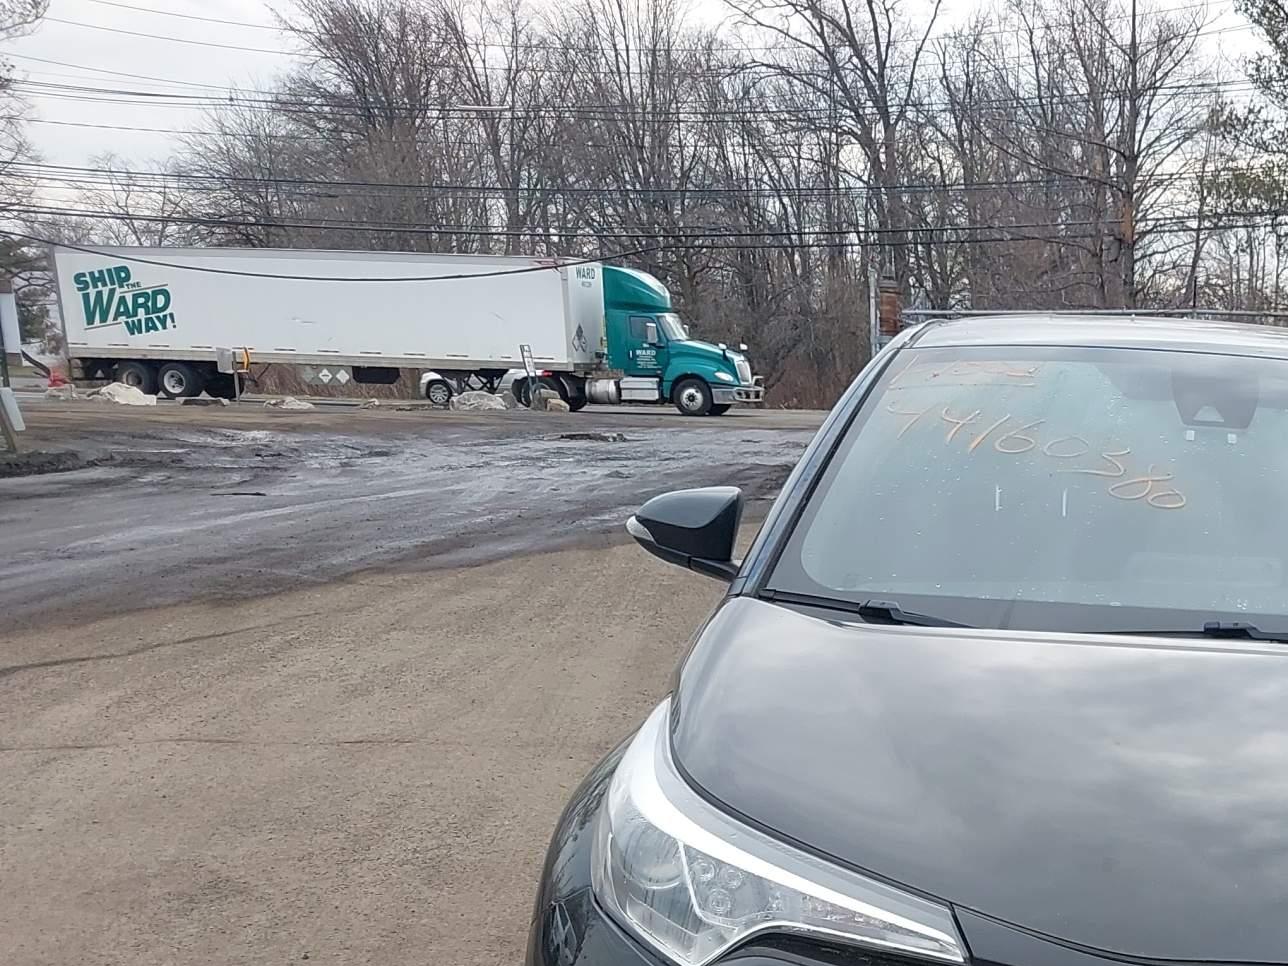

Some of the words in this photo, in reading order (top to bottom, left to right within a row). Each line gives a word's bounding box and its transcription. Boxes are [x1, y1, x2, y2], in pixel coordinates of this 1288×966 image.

[74, 266, 131, 292] SHIP
[576, 267, 596, 279] WARD
[82, 287, 171, 326] WARD
[124, 312, 177, 336] WAY!
